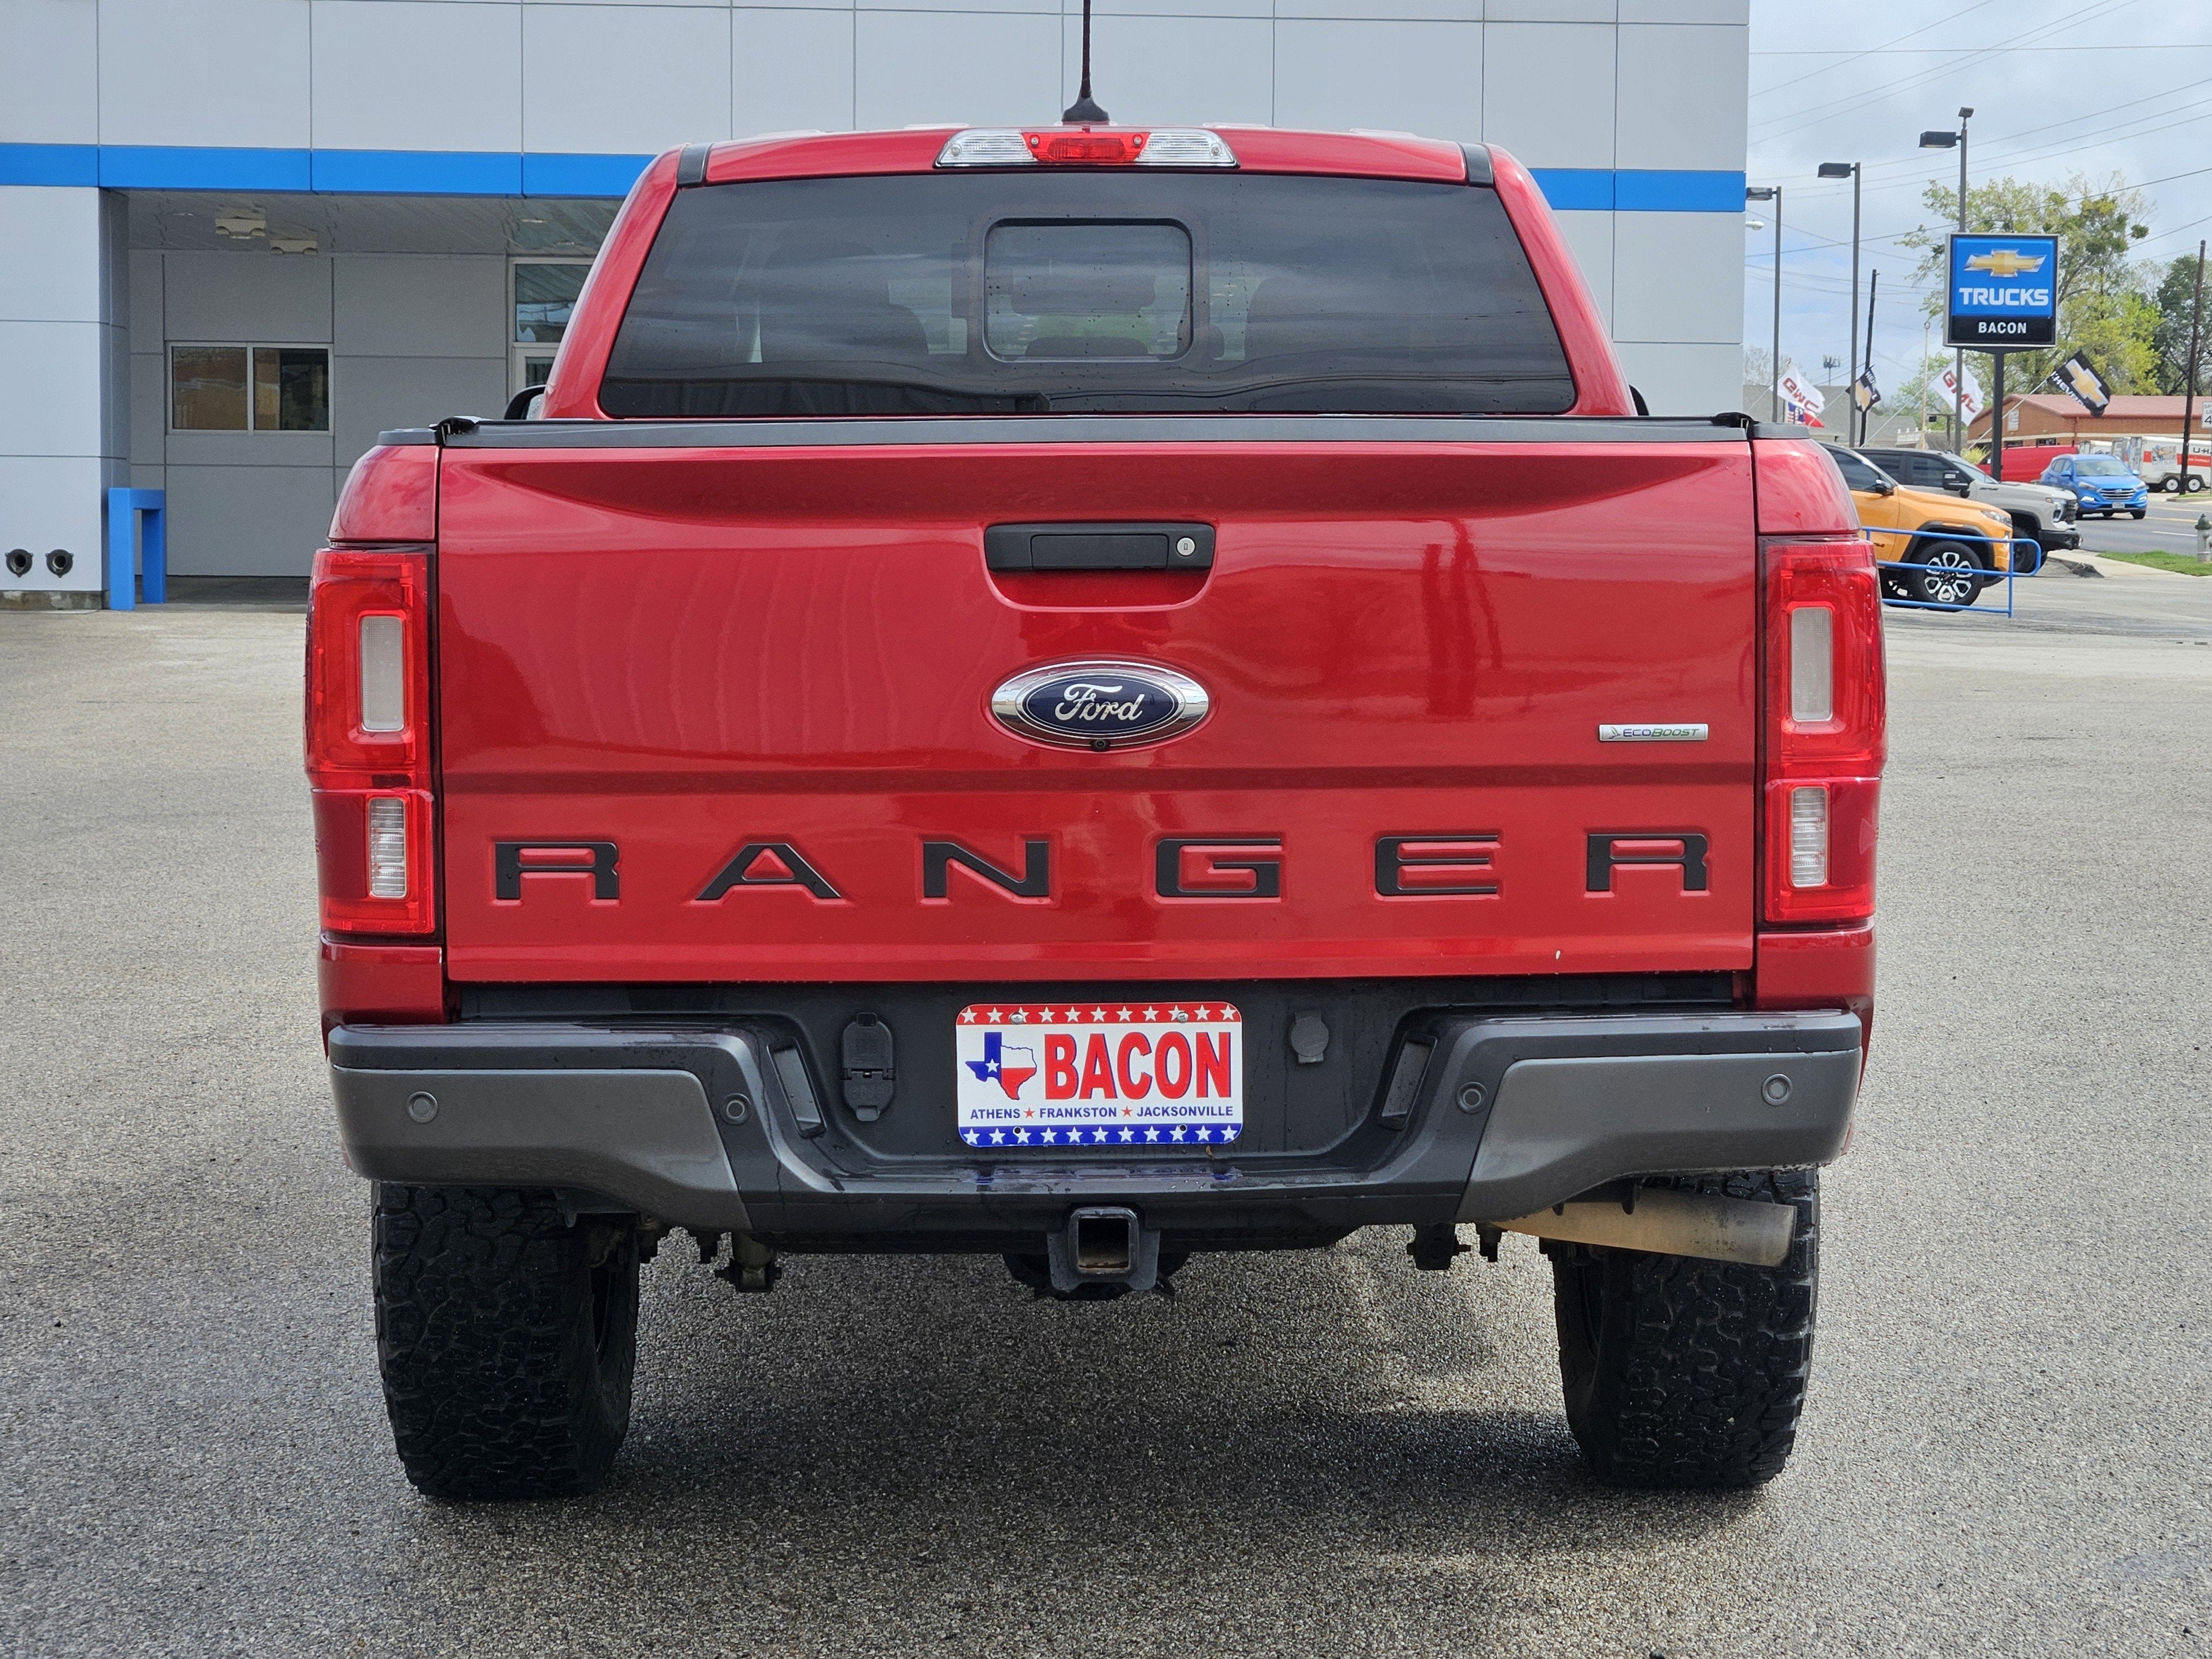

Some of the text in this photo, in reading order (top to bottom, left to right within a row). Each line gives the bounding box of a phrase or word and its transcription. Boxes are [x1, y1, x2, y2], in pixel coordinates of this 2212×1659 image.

[1959, 288, 2049, 306] TRUCKS
[1979, 322, 2027, 333] BACON
[1055, 683, 1145, 720] Ford
[1623, 729, 1699, 737] ECOBOOST
[494, 833, 1708, 901] RANGER
[1044, 1032, 1231, 1100] BACON
[970, 1106, 1233, 1119] ATHENS FRANKSTON JACKSONVILLE
